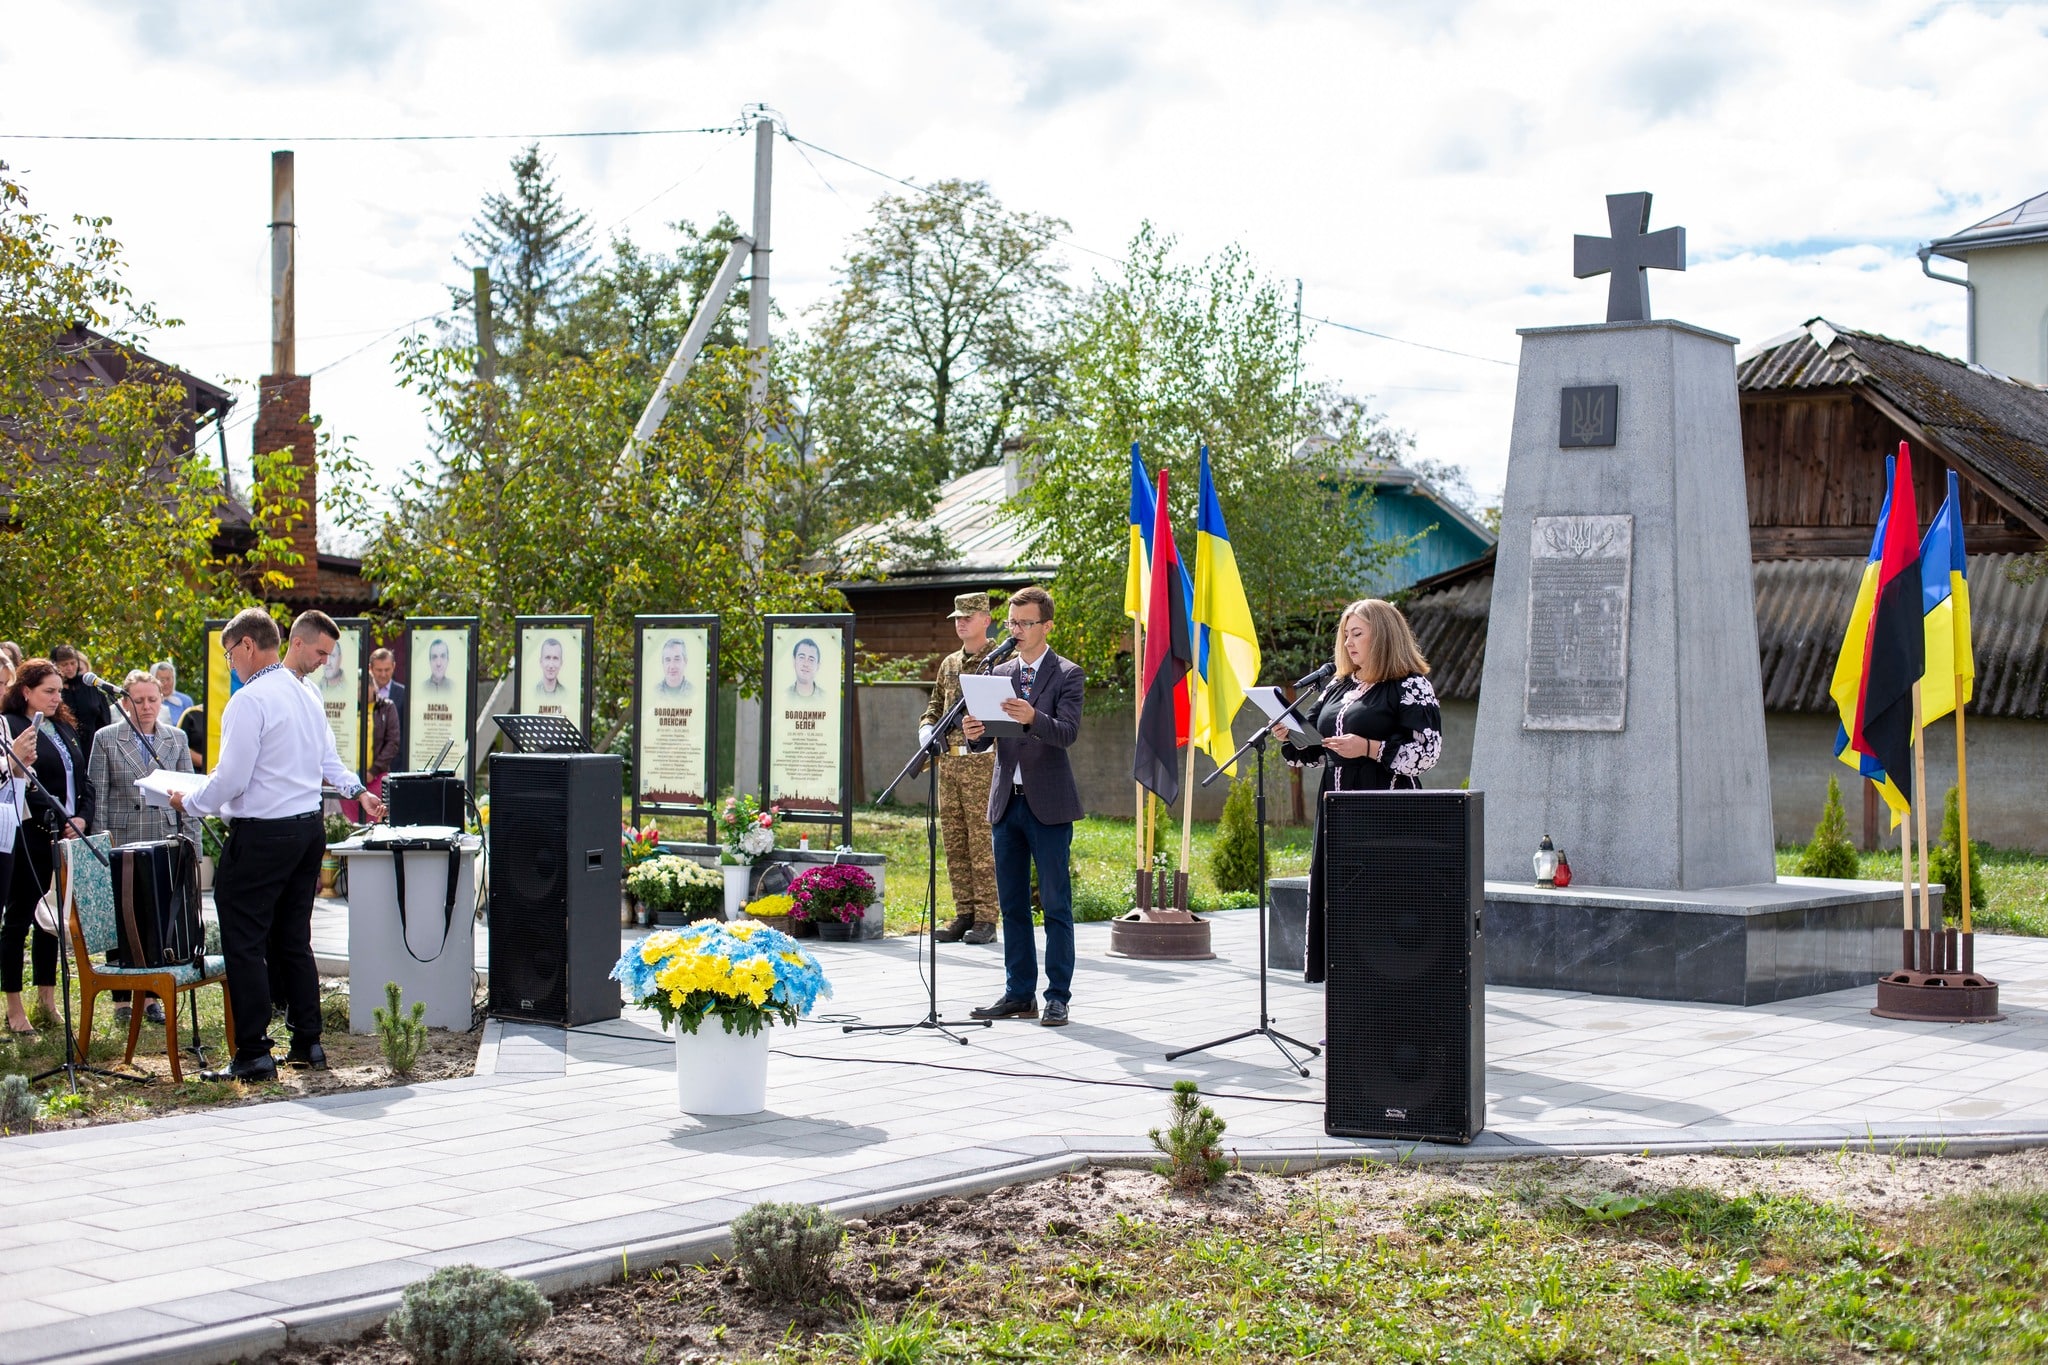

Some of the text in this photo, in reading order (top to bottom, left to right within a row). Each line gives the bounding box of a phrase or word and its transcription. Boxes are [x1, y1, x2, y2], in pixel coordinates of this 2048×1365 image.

[427, 704, 449, 712] ВАСИЛЬ
[538, 705, 562, 714] ДМИТРО
[654, 708, 692, 717] ВОЛОДИМИР
[785, 710, 827, 720] ВОЛОДИМИР
[659, 717, 687, 726] ОЛЕКСИН
[795, 719, 815, 730] БЕЛЕЙ
